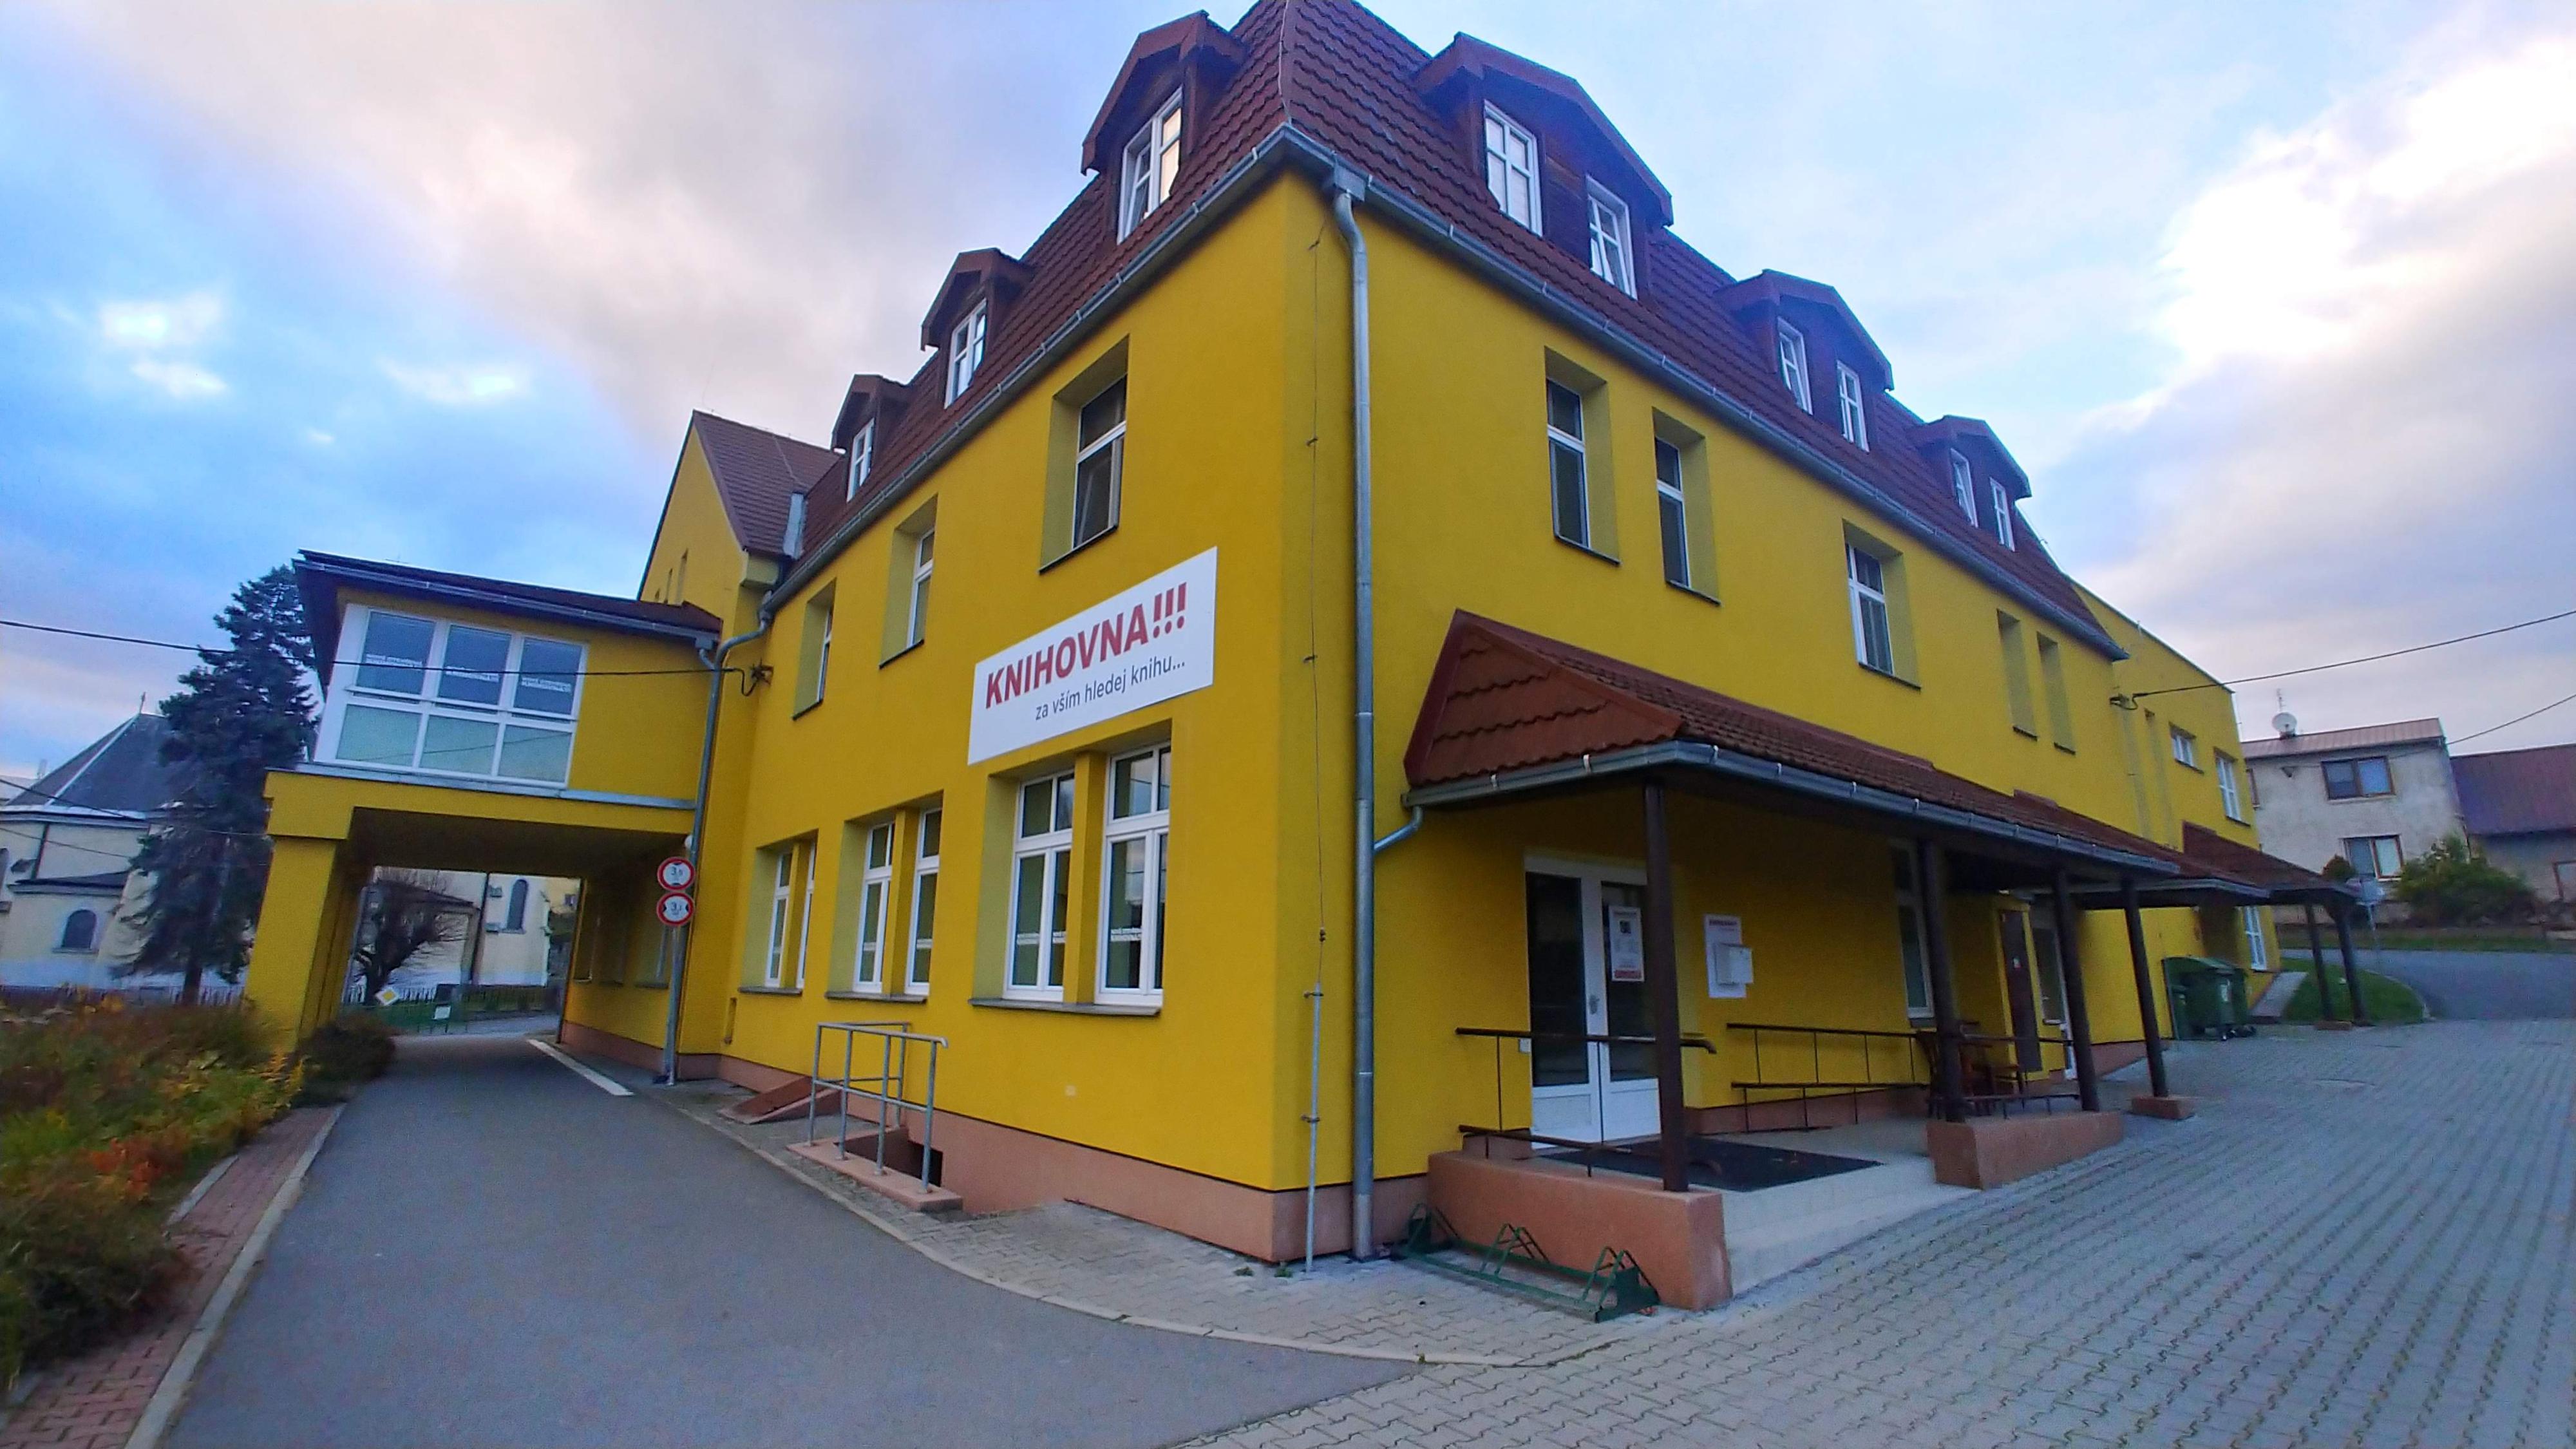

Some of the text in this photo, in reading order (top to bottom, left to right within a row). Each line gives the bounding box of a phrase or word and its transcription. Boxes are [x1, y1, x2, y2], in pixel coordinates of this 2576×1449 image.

[985, 582, 1187, 709] KNIHOVNA!!!
[1036, 656, 1186, 721] za vším hledej knihu...
